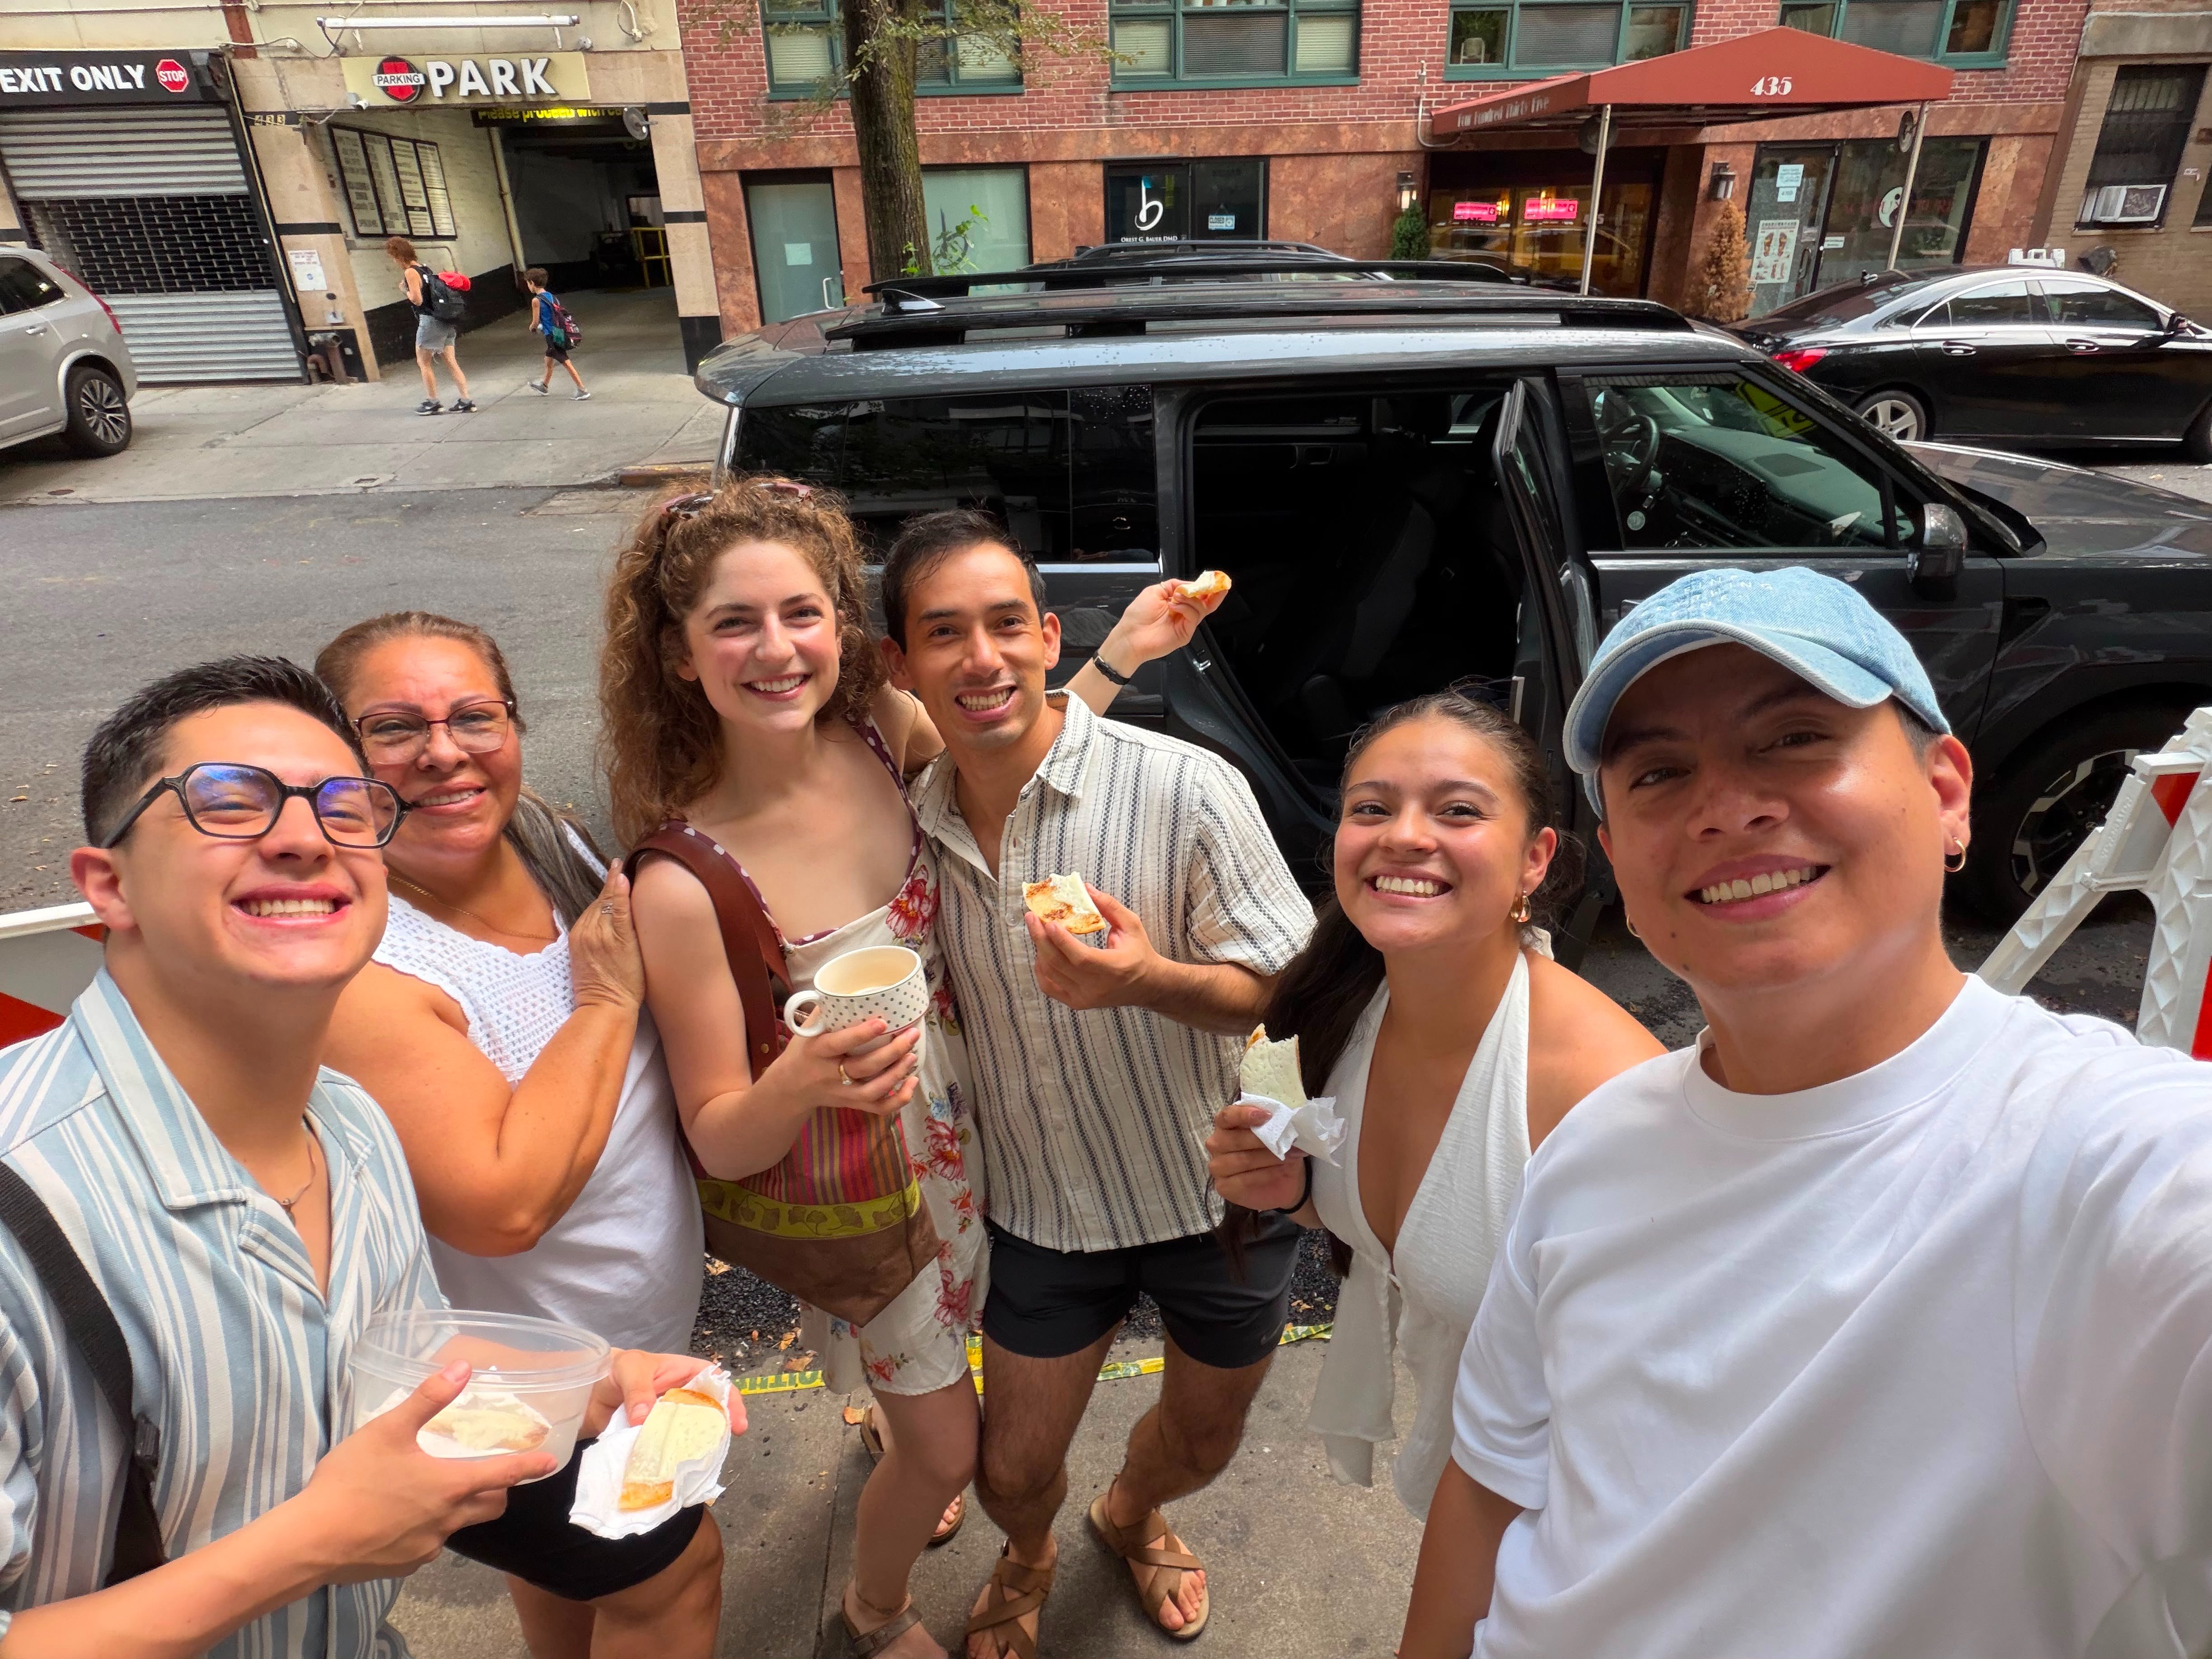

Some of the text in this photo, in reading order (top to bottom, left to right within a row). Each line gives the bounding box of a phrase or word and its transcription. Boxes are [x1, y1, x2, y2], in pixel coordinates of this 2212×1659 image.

[0, 64, 145, 93] EXIT ONLY
[159, 70, 185, 83] STOP
[377, 74, 420, 84] PARKING
[426, 58, 556, 97] PARK
[1750, 76, 1792, 95] 435
